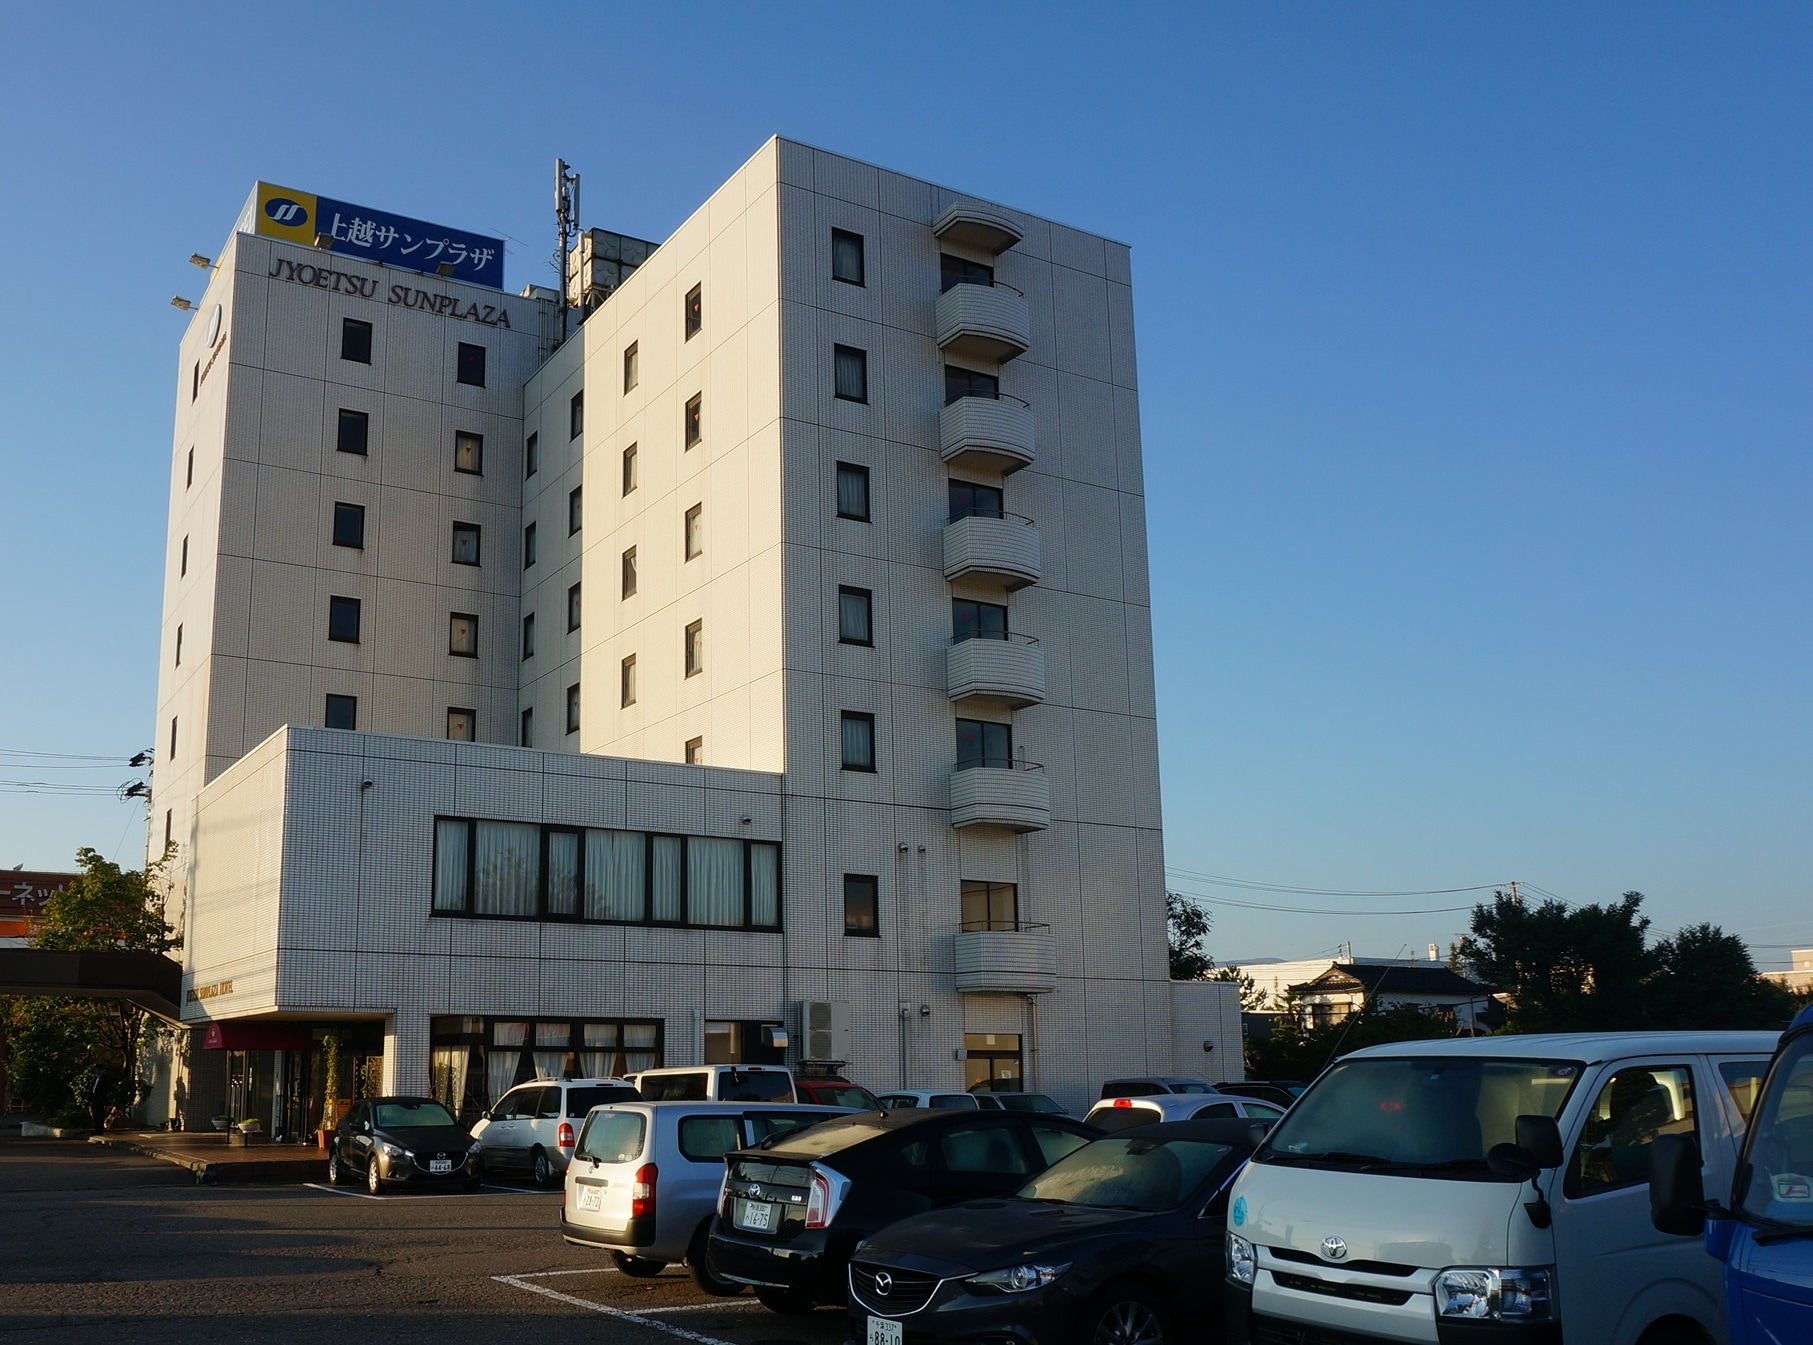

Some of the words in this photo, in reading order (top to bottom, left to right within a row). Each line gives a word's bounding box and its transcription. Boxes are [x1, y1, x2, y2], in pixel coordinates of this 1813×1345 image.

[331, 212, 495, 271] 上越サンプラザ
[269, 258, 379, 298] JYOETSU
[388, 285, 511, 328] SUNPLAZA
[749, 1212, 769, 1227] 16-75
